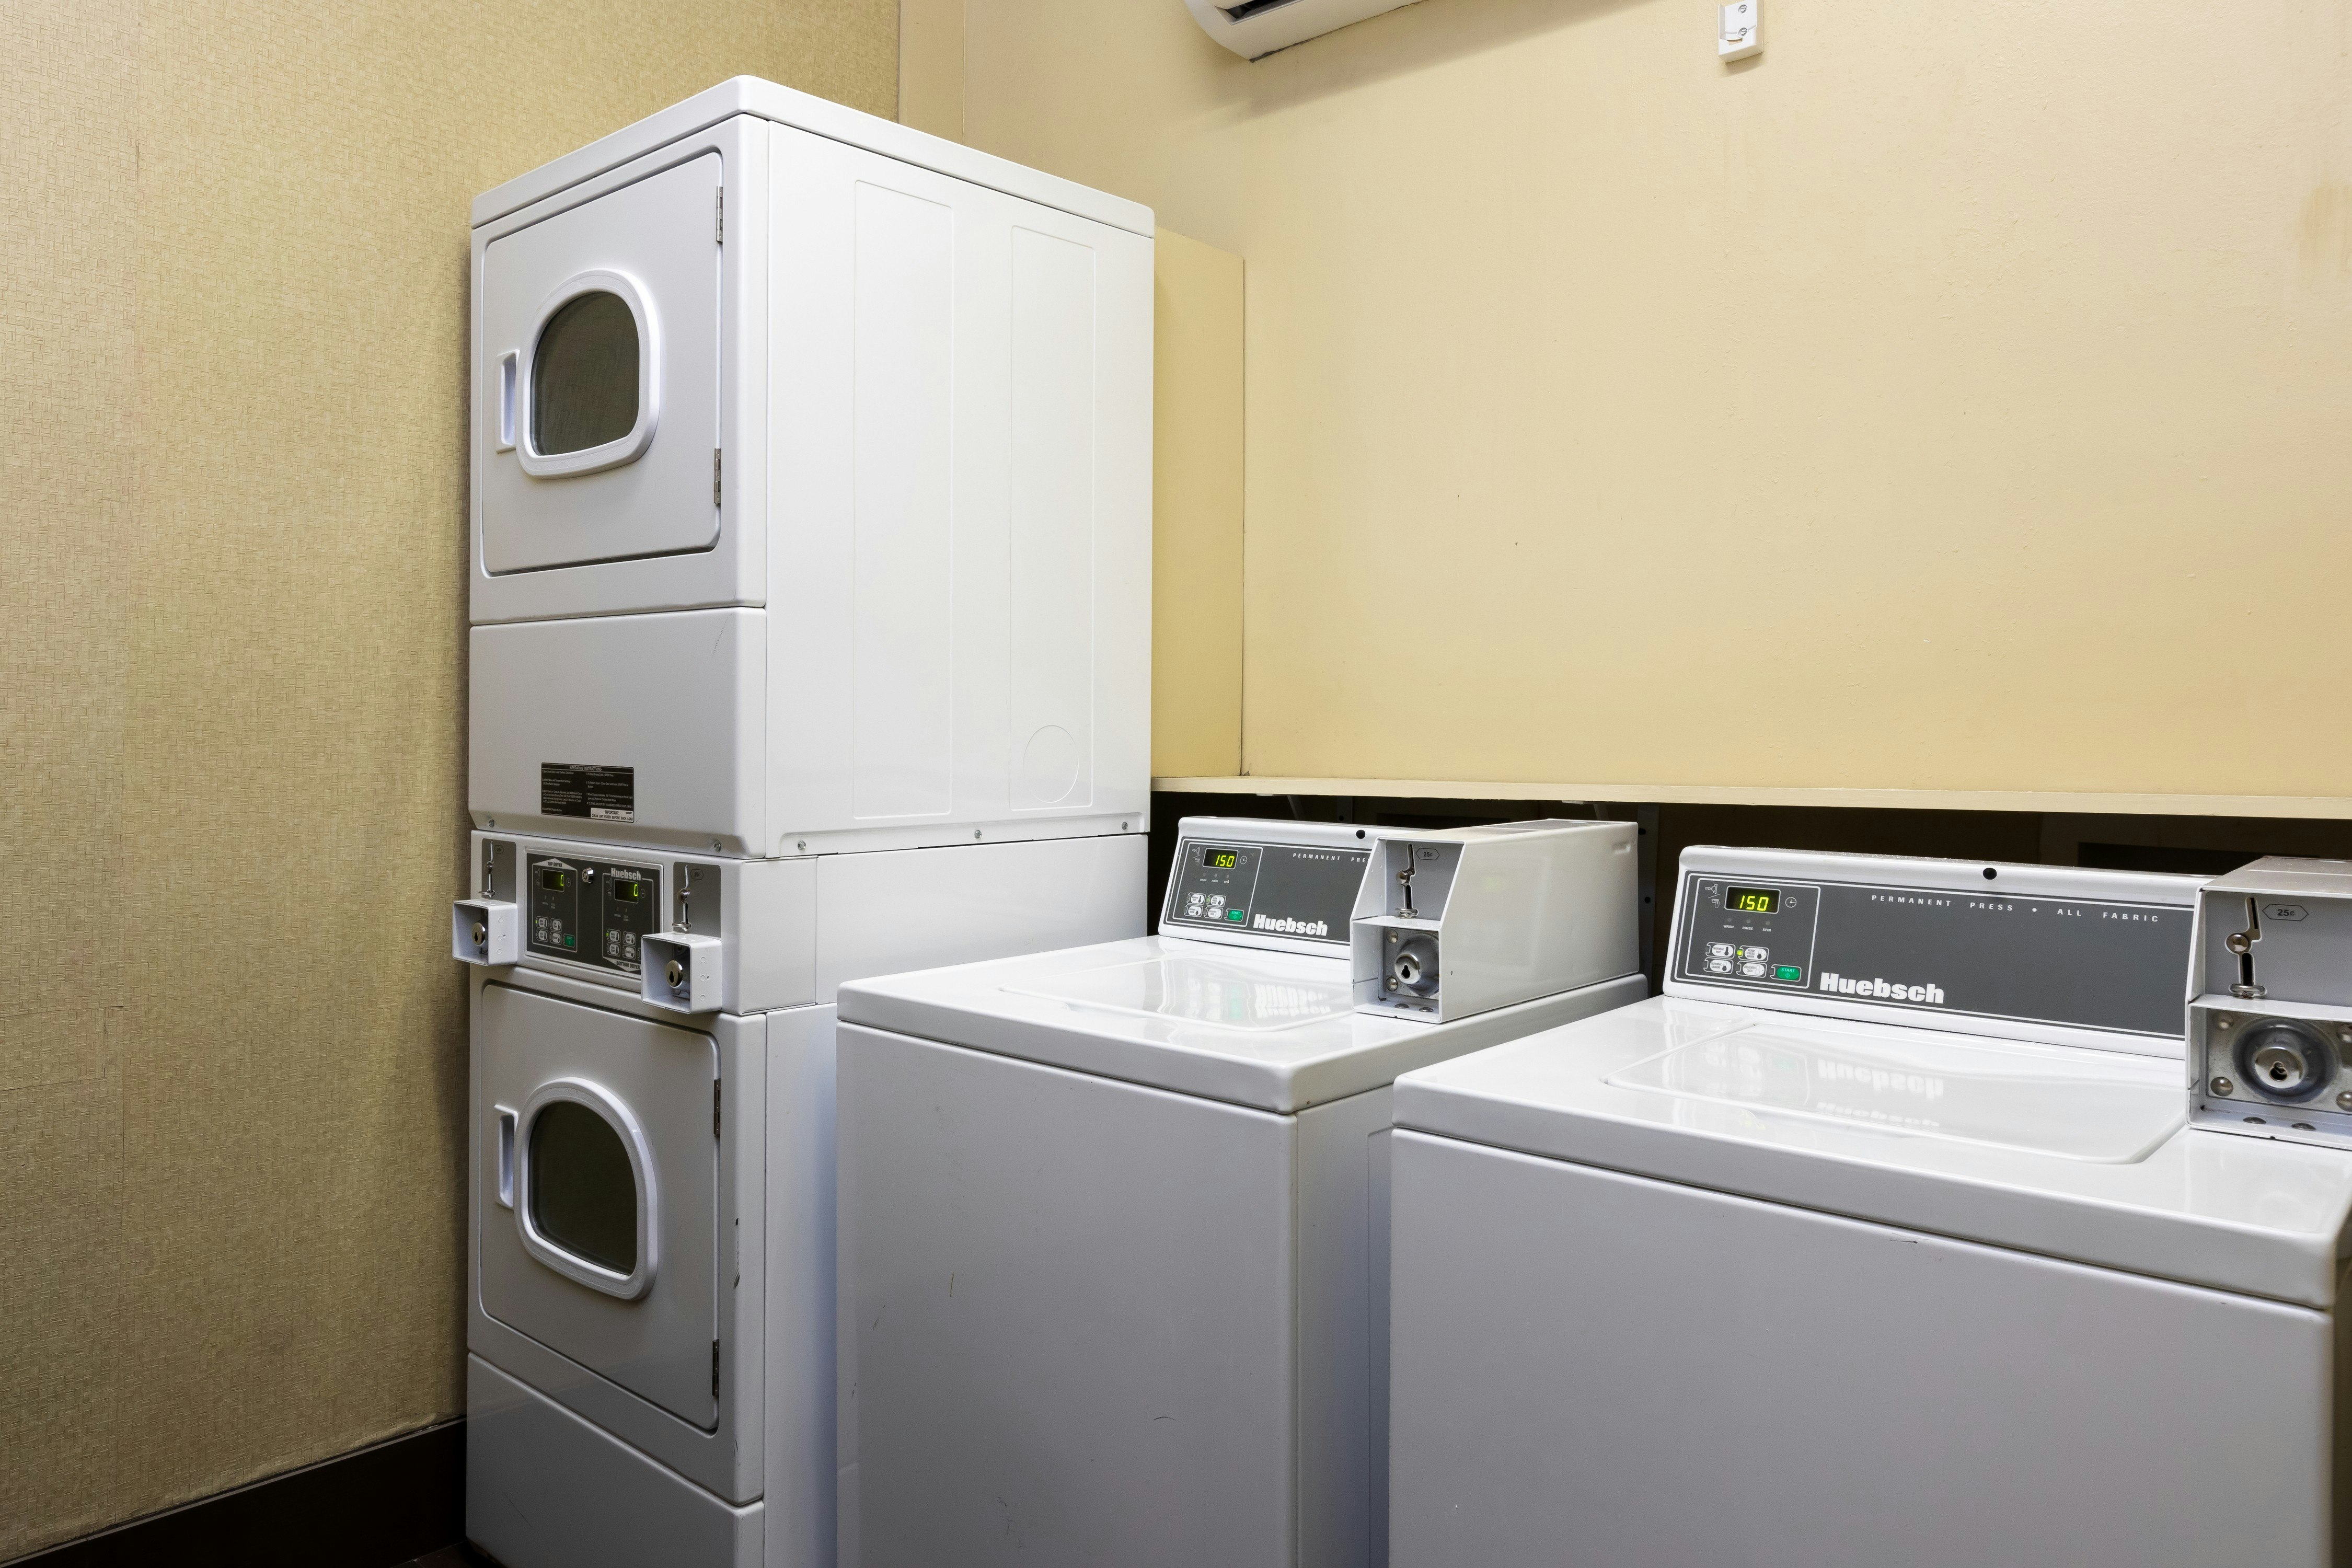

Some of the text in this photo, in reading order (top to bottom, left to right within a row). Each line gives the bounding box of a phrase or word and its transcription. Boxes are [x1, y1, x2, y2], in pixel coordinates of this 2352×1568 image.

[1215, 855, 1235, 867] 150
[610, 868, 641, 881] Huebsch
[1739, 895, 1769, 911] 150
[1872, 895, 1951, 906] PERMANENT
[1970, 902, 2013, 911] PRESS
[2103, 912, 2158, 922] FABRIC
[1253, 914, 1328, 936] Huebsch
[1819, 972, 1944, 1004] Huebsch
